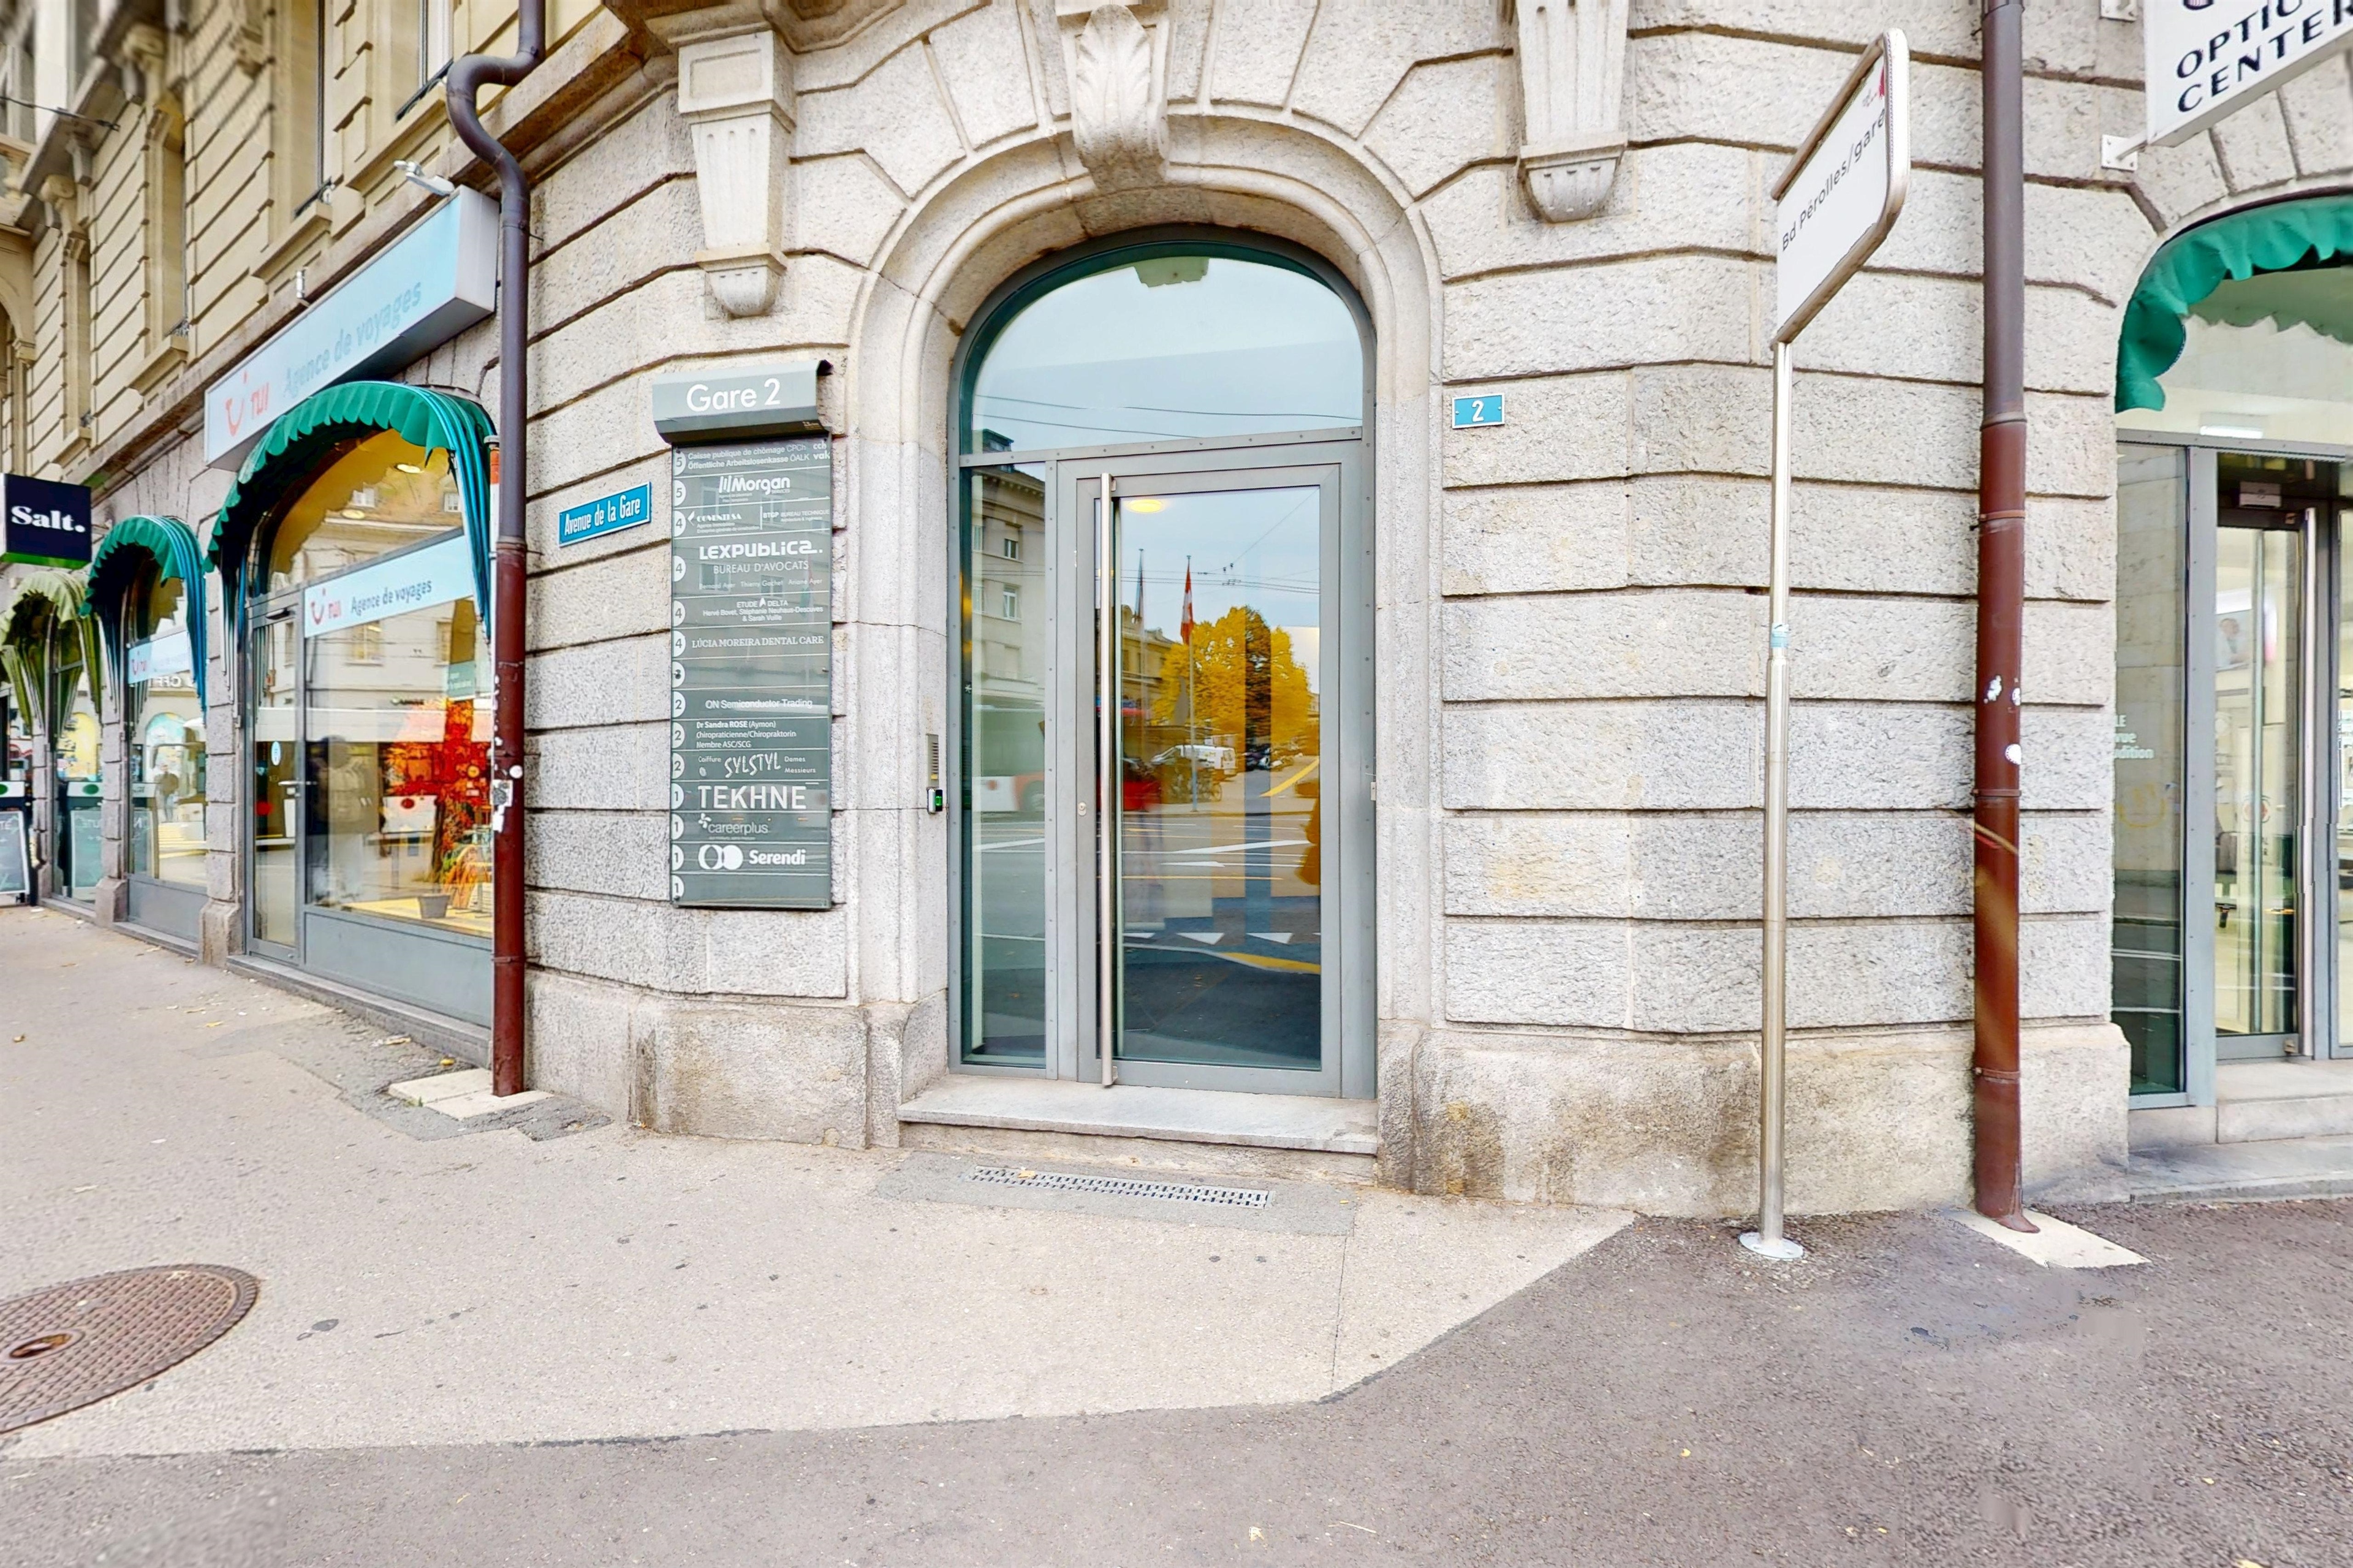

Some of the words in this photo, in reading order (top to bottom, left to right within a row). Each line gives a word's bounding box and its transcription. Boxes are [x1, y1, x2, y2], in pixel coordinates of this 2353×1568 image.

[1782, 221, 1796, 252] Bd
[283, 349, 330, 399] Agence
[334, 328, 352, 363] de
[356, 281, 422, 344] voyages
[686, 384, 757, 412] Gare
[764, 377, 781, 406] 2
[1472, 400, 1484, 422] 2
[712, 449, 742, 460] publique
[743, 447, 752, 456] de
[752, 446, 786, 455] chômage
[675, 456, 683, 468] 5
[688, 460, 725, 470] Öffentliche
[726, 456, 789, 468] Arbeitslosenkasse
[675, 487, 683, 498] 5
[730, 477, 791, 496] Morgan
[11, 506, 86, 532] Salt.
[564, 513, 592, 536] Avenue
[594, 503, 605, 527] de
[607, 499, 616, 523] la
[619, 494, 641, 519] Gare
[675, 518, 683, 529] 4
[675, 562, 683, 574] 4
[713, 564, 750, 575] BUREAU
[754, 560, 809, 572] D'AVOCATS
[351, 596, 380, 616] Agence
[382, 586, 394, 605] de
[394, 580, 432, 604] voyages
[675, 608, 683, 619] 4
[675, 638, 682, 649] 4
[718, 637, 762, 647] MOREIRA
[761, 636, 798, 645] DENTAL
[798, 635, 824, 645] CARE
[675, 699, 682, 710] 2
[705, 700, 720, 709] ON
[721, 699, 780, 709] Semiconductor
[781, 698, 813, 709] Trading
[704, 721, 729, 729] Sandra
[748, 720, 776, 730] (Aymon)
[675, 730, 682, 741] 2
[722, 740, 752, 749] ASC/SCG
[674, 761, 681, 771] 2
[724, 751, 782, 779] SYLSTYL
[697, 785, 807, 809] TEKHNE
[708, 821, 769, 836] careerplus
[749, 849, 806, 865] Serendi
